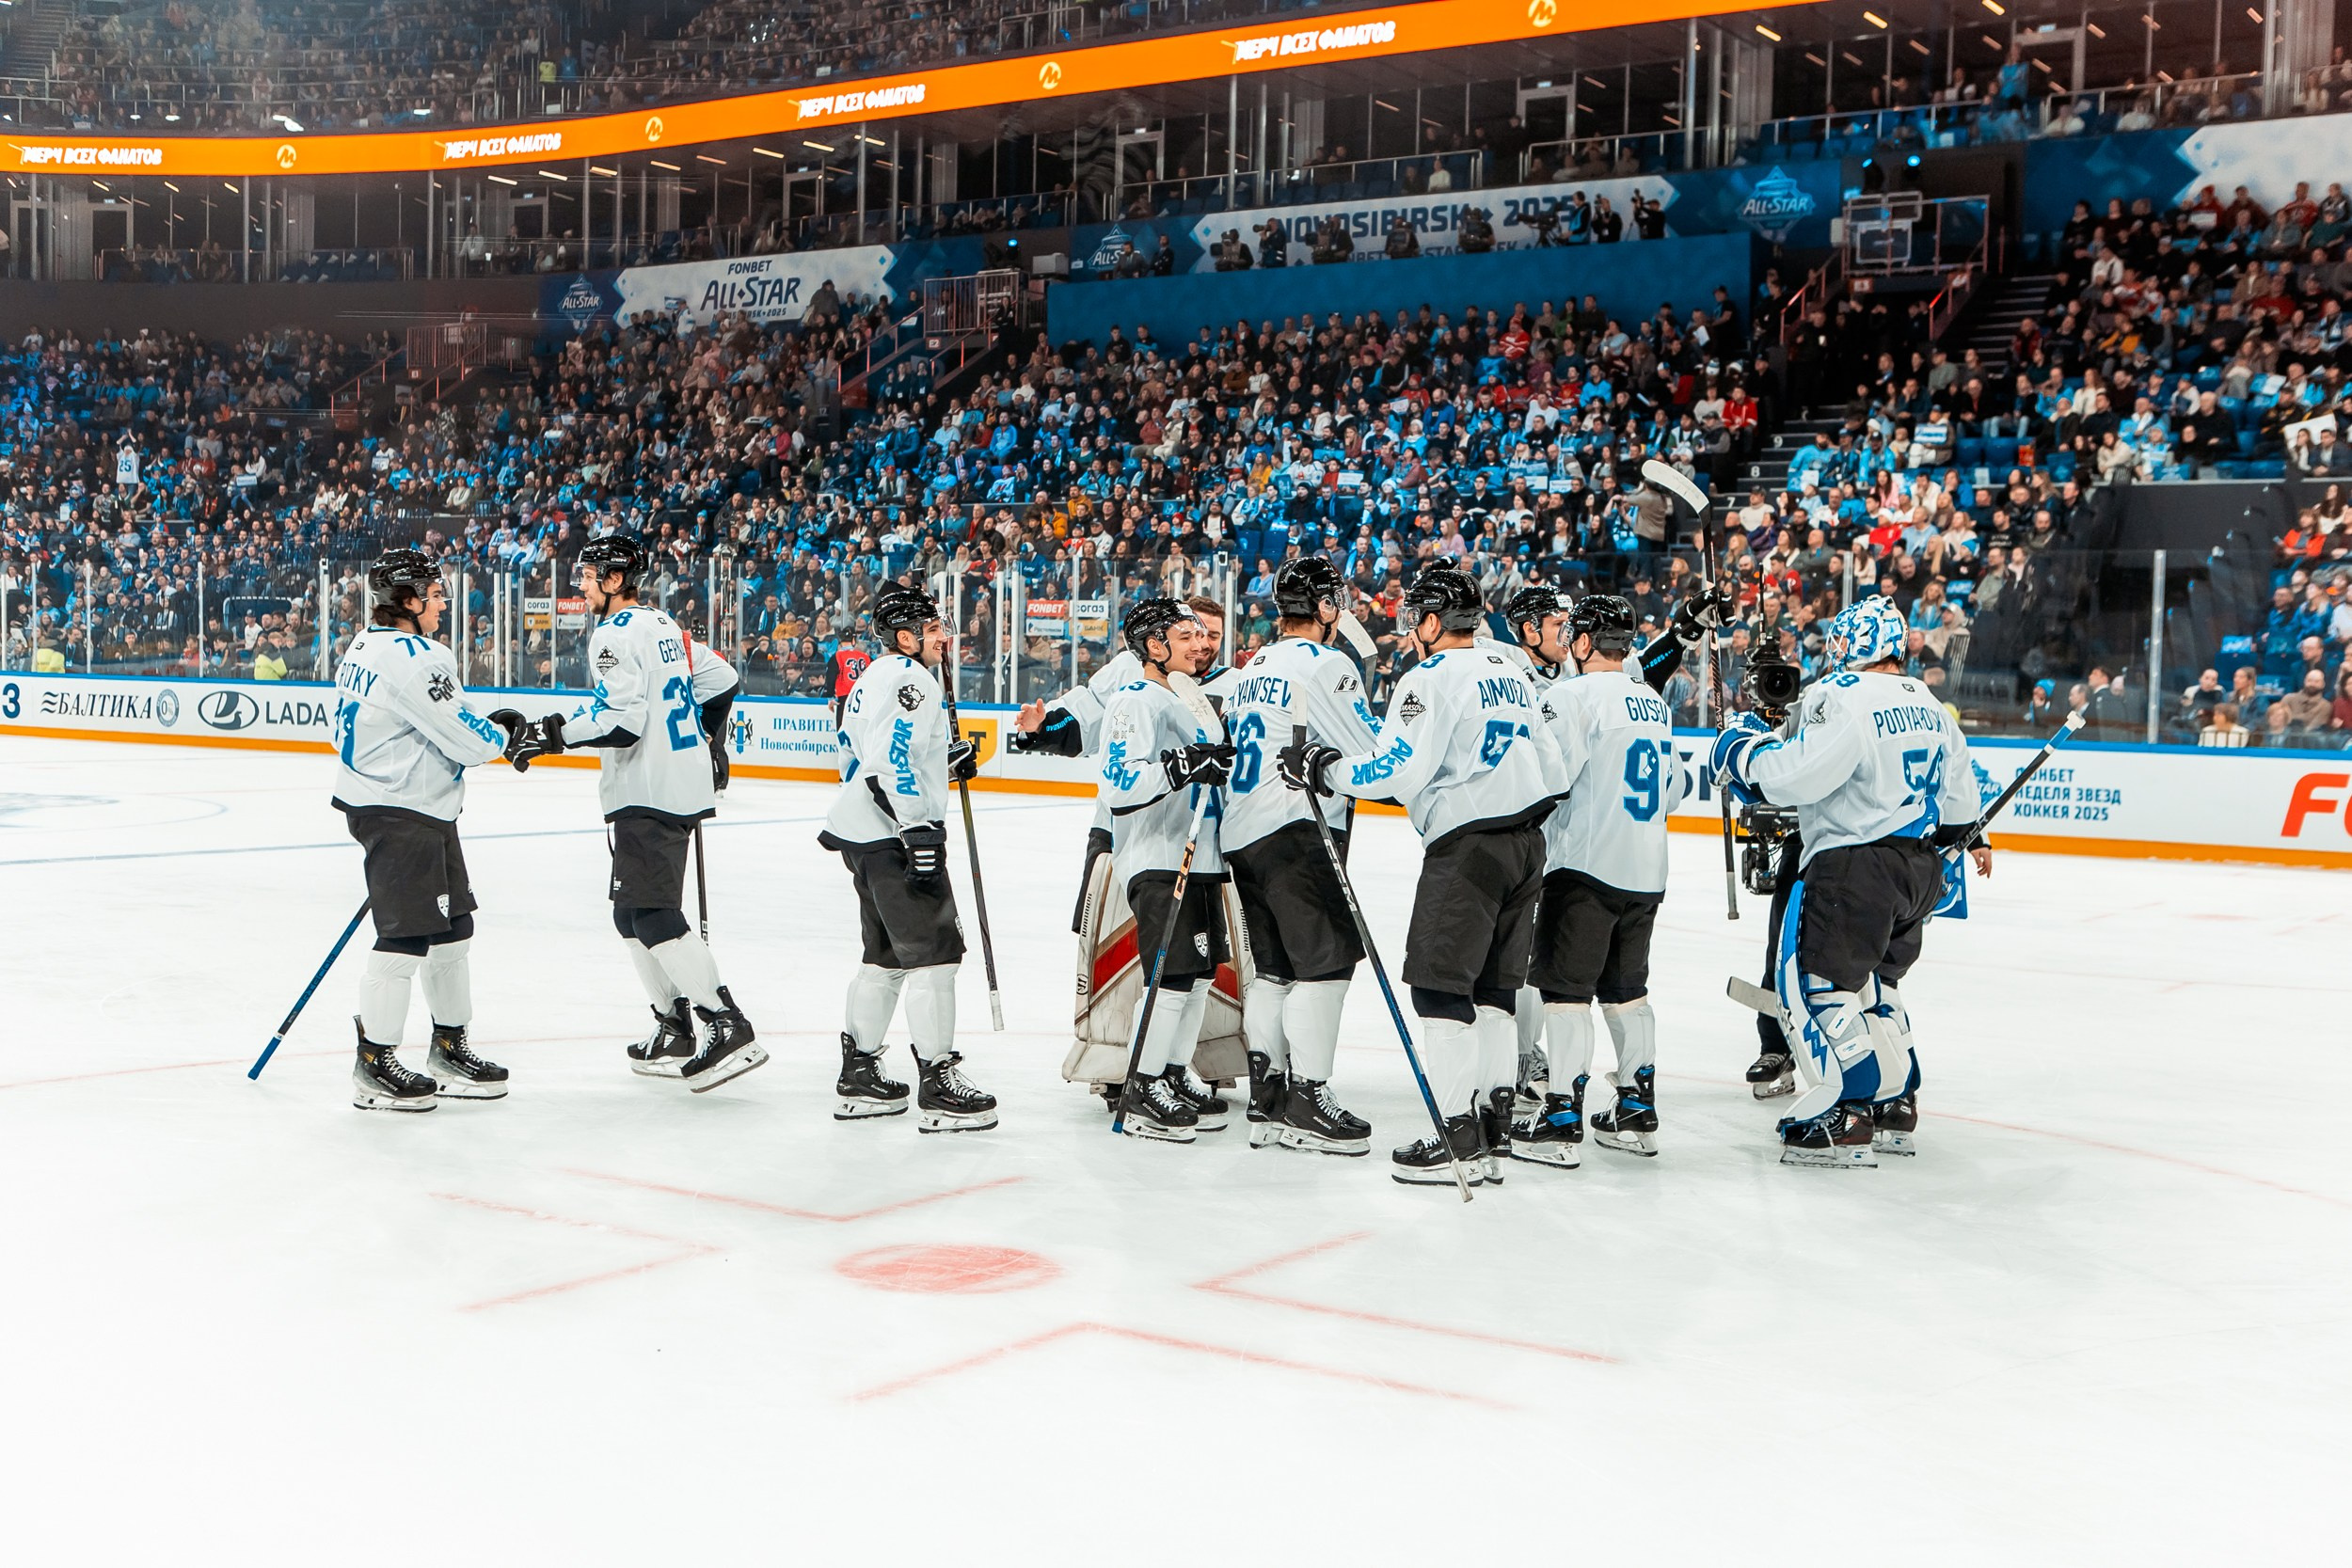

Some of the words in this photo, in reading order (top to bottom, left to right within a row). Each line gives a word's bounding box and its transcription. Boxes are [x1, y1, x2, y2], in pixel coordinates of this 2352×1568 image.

[727, 260, 772, 275] FONBET
[766, 308, 787, 317] 2025
[1773, 436, 1783, 448] 9
[1751, 466, 1760, 477] 8
[1727, 497, 1736, 509] 7
[558, 602, 585, 610] FONBET
[1027, 603, 1064, 613] FONBET
[394, 634, 431, 657] 71
[2, 682, 21, 720] 3
[58, 689, 152, 721] БАЛТИКА
[265, 701, 329, 727] LADA
[773, 718, 837, 733] ПРАВИТЕ
[2014, 785, 2071, 801] НЕДЕЛЯ
[2075, 788, 2122, 805] ЗВЕЗД
[2013, 803, 2070, 819] ХОККЕЯ
[2074, 806, 2109, 821] 2025
[2280, 771, 2352, 840] F
